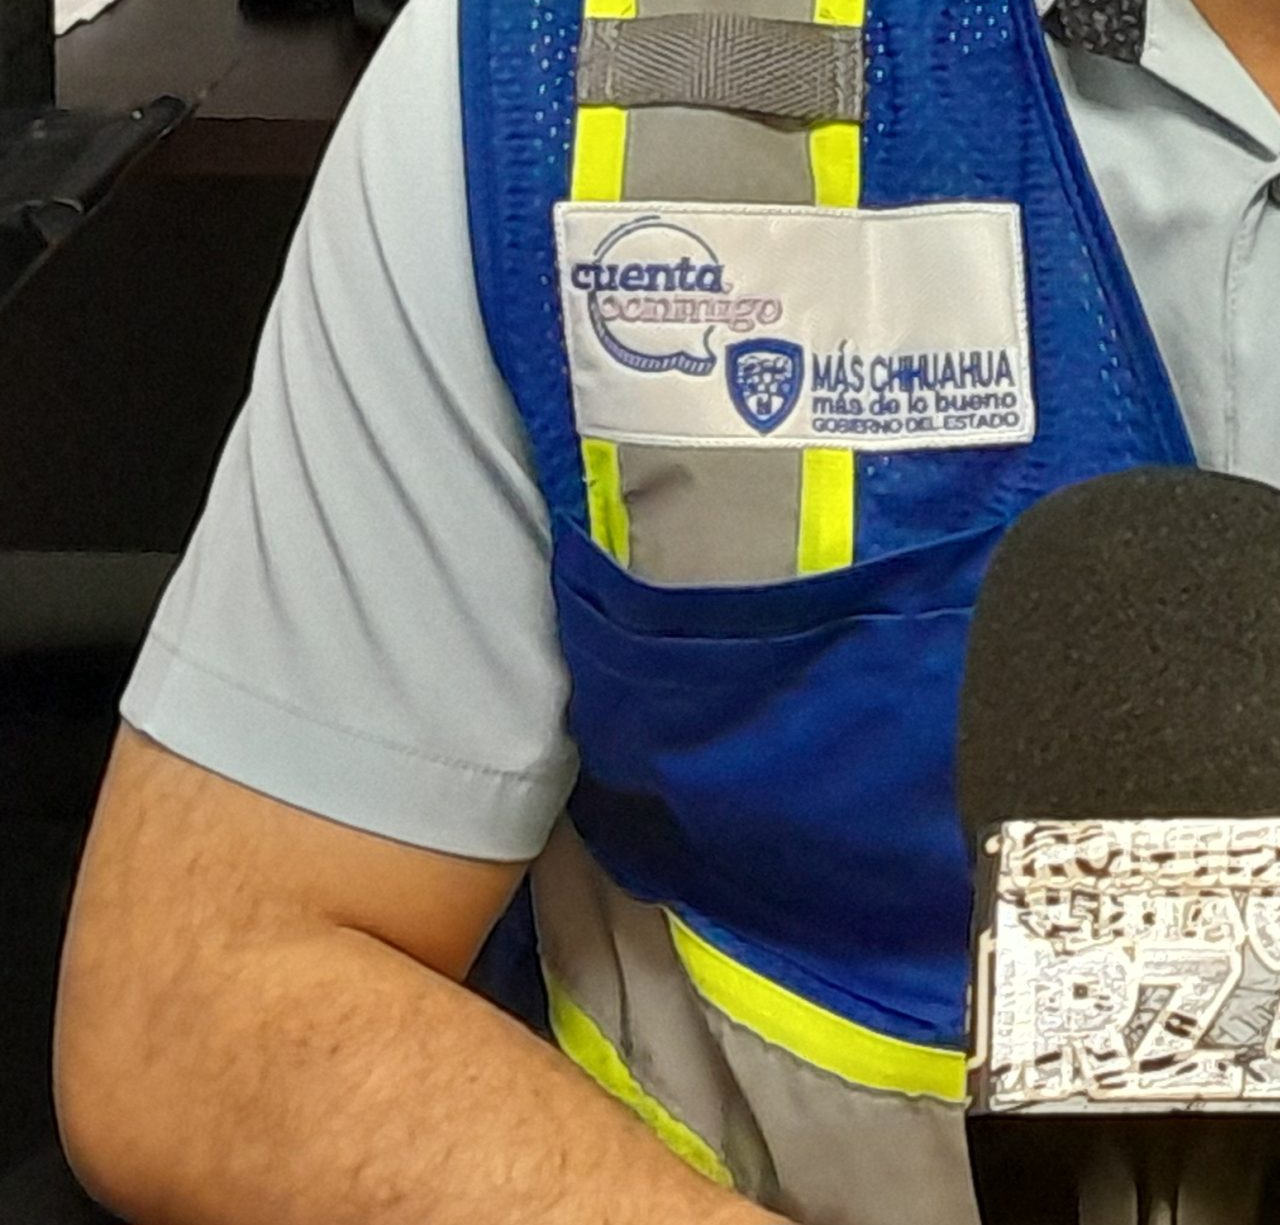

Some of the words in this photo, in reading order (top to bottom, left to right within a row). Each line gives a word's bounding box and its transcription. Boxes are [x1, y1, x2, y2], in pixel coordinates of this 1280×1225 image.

[571, 257, 724, 293] cuenta
[811, 339, 864, 393] MÁS
[870, 349, 1016, 393] CHIHUAHUA
[935, 391, 1017, 414] bueno
[943, 410, 1020, 431] ESTADO
